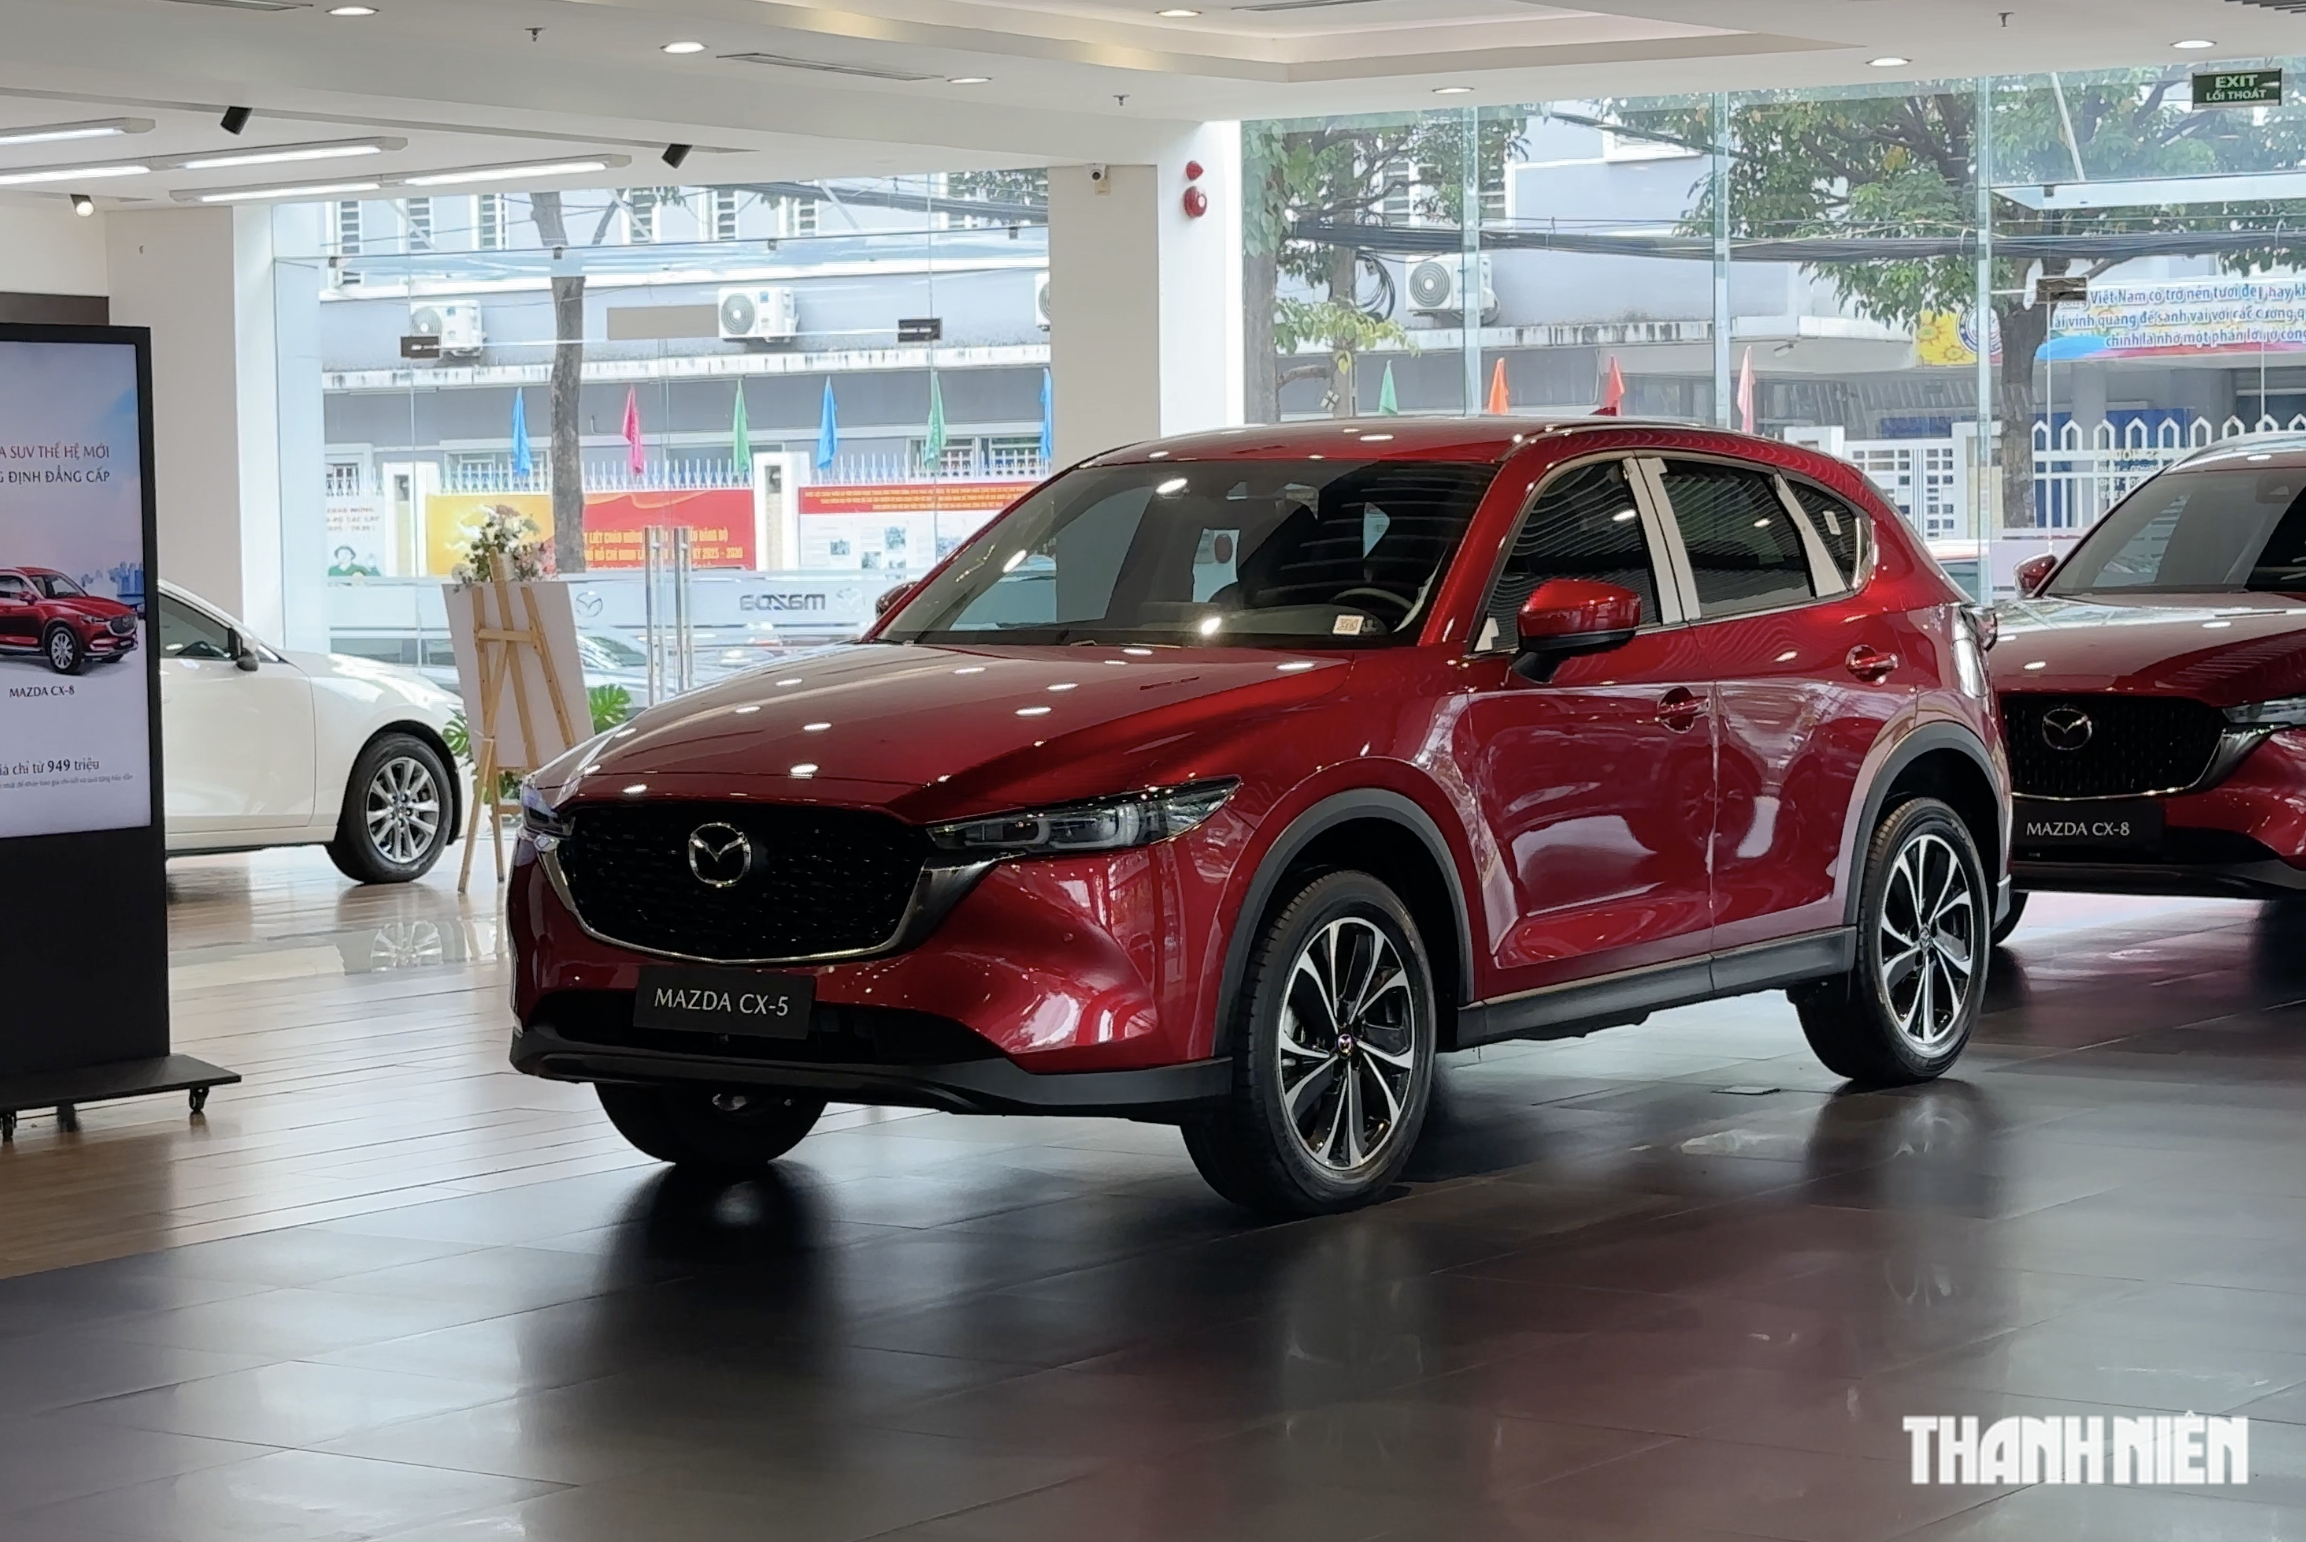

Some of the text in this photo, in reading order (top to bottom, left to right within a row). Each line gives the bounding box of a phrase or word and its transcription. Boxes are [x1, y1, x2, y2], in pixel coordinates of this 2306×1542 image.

[2215, 74, 2259, 89] EXIT
[2206, 87, 2267, 101] LỐI THOÁT
[2090, 289, 2113, 304] Việt
[2118, 289, 2146, 303] Nam
[2269, 285, 2291, 302] hay
[2068, 312, 2095, 328] vinh
[2098, 315, 2136, 331] quang
[2190, 307, 2208, 322] vai
[10, 445, 35, 459] SUV
[38, 440, 61, 459] THẾ
[64, 442, 80, 461] HỆ
[83, 442, 110, 459] MỚI
[8, 470, 41, 485] ĐỊNH
[45, 464, 82, 483] ĐẲNG
[86, 465, 110, 483] CẤP
[9, 684, 76, 698] MAZDA CX-8
[12, 759, 31, 776] chỉ
[32, 760, 45, 774] từ
[47, 758, 71, 773] 949
[74, 756, 101, 773] triệu
[2026, 821, 2130, 836] MAZDA CX-8
[654, 987, 789, 1016] MAZDA CX-5
